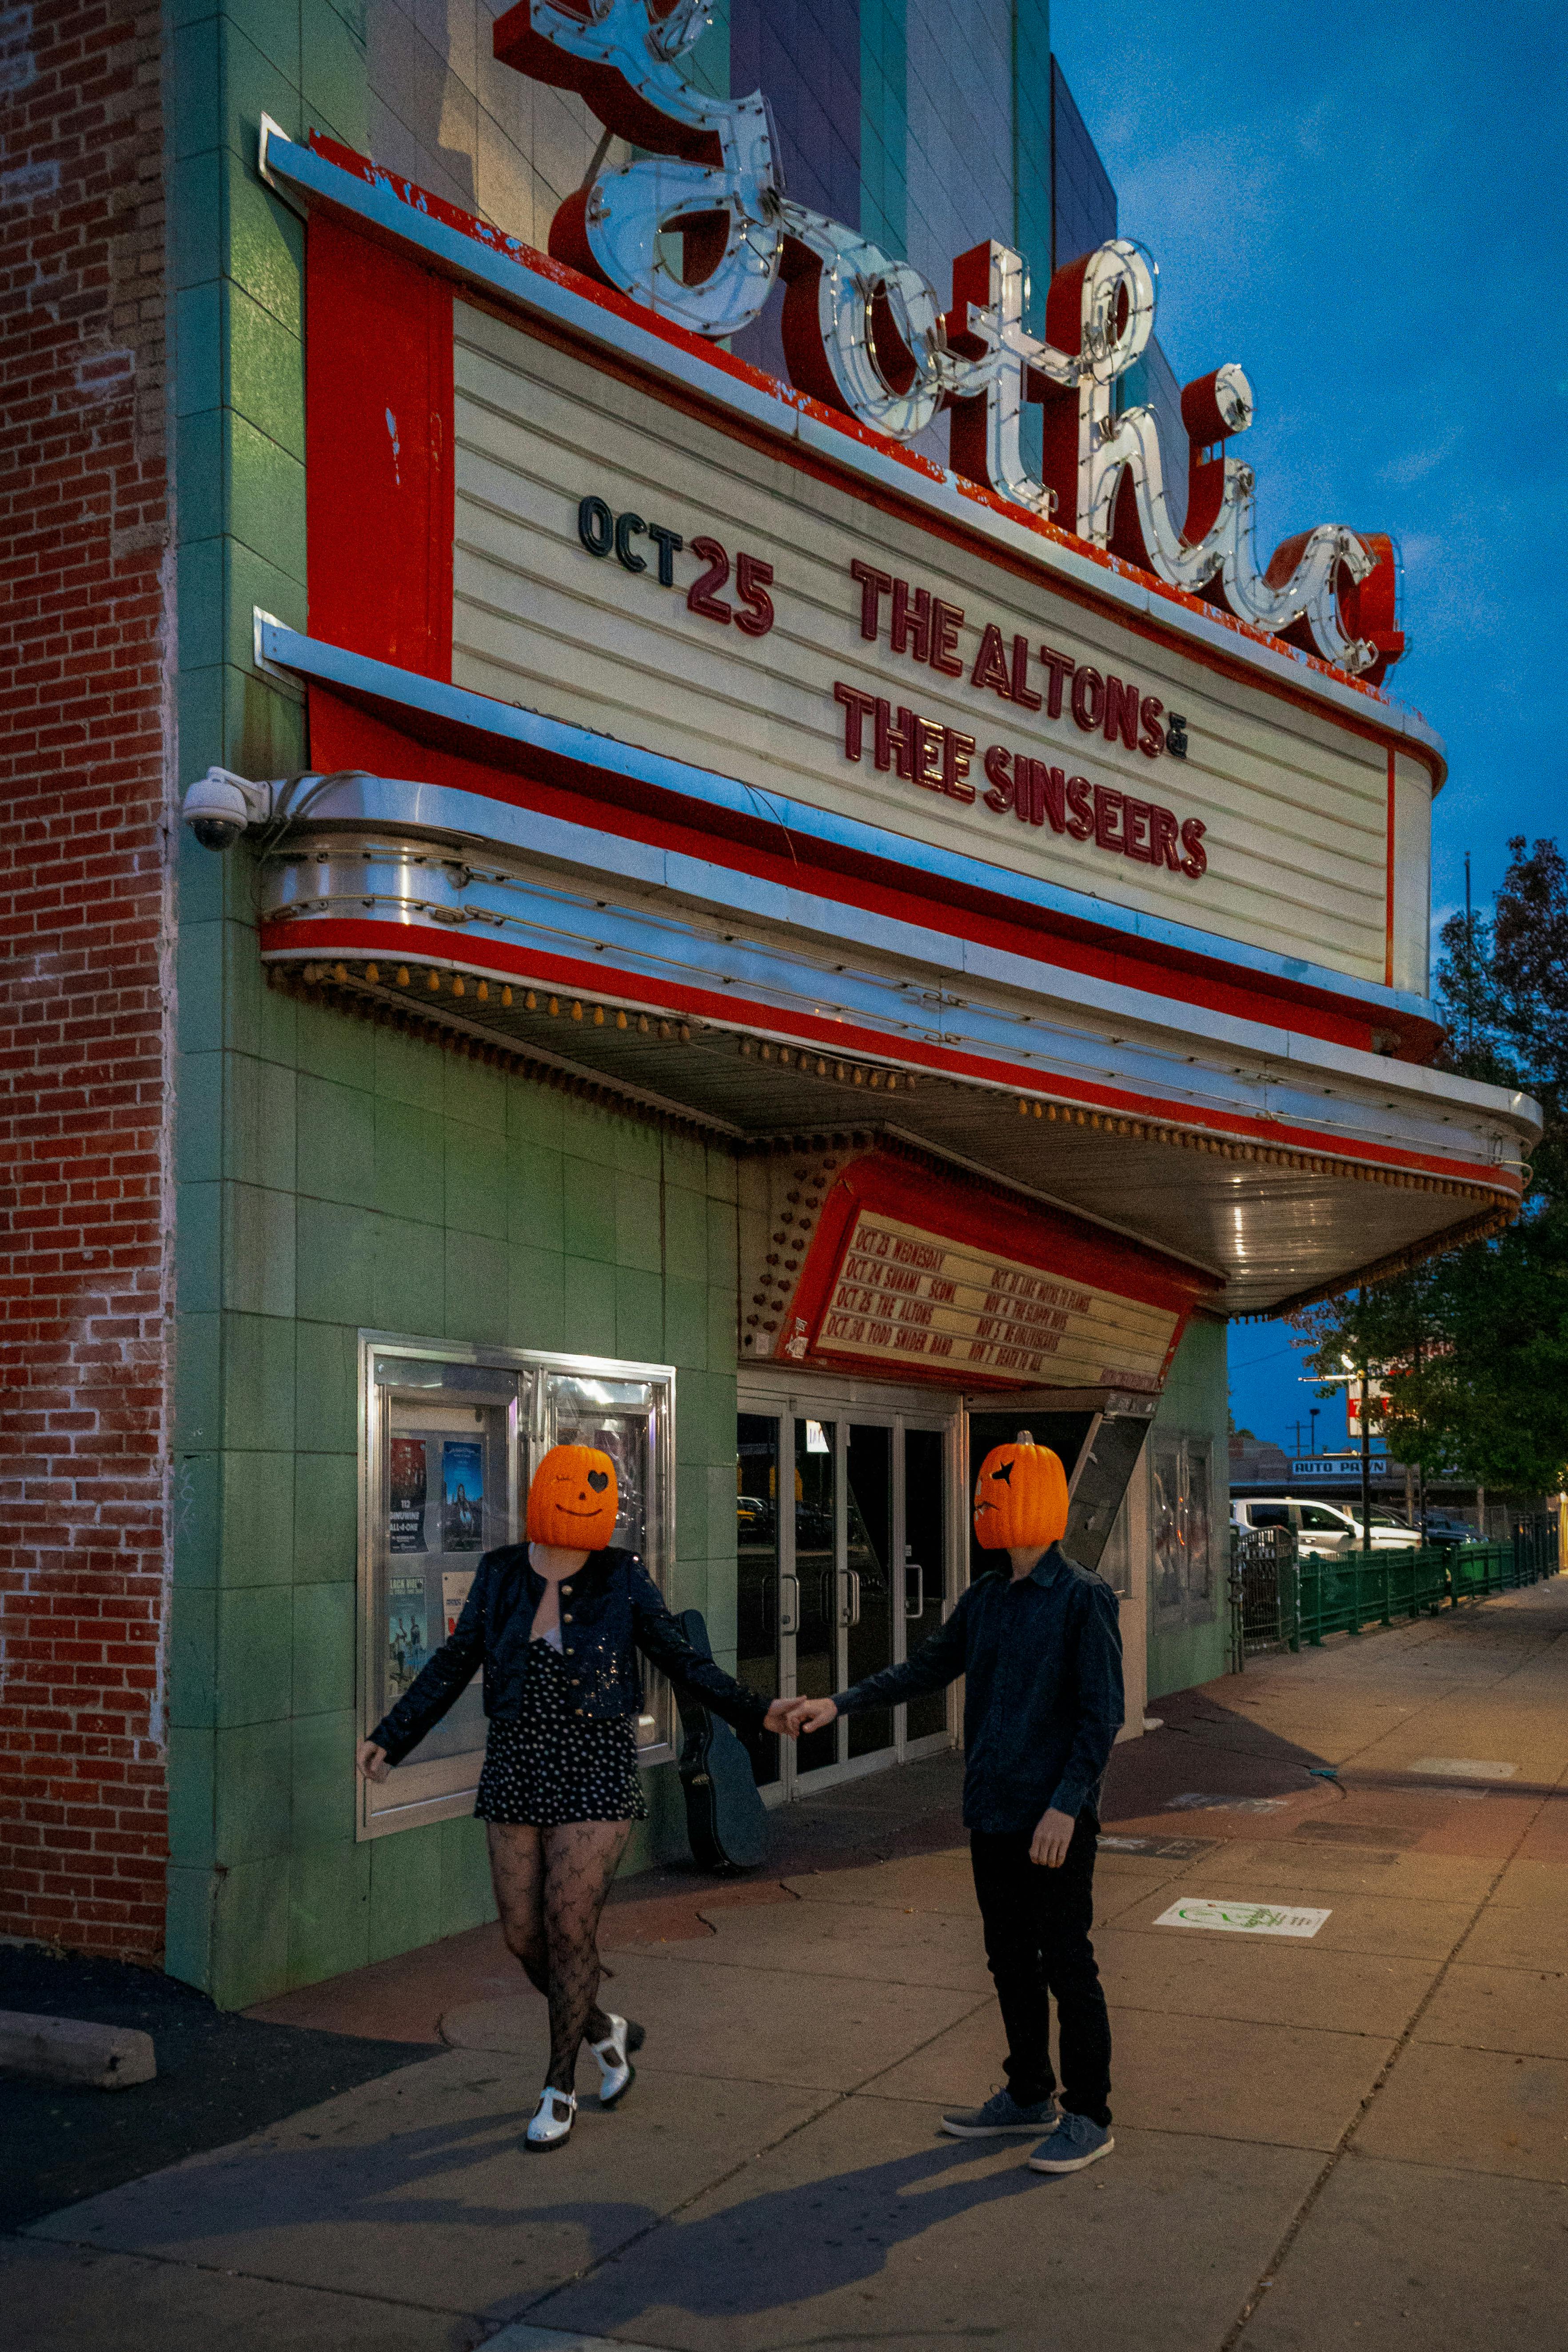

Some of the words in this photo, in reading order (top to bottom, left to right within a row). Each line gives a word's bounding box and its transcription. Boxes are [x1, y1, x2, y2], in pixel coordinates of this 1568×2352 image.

[578, 495, 683, 587] OCT
[687, 535, 774, 638] 25
[850, 558, 965, 678] THE
[971, 623, 1165, 759] ALTONS
[834, 681, 976, 804] THEE
[983, 745, 1207, 880] SINSEERS
[855, 1227, 877, 1251] OCT
[877, 1234, 890, 1255] 23
[893, 1239, 944, 1270] WEDNESDAY
[846, 1257, 867, 1279] OCT
[868, 1263, 882, 1283] 24
[836, 1286, 858, 1307] OCT
[859, 1291, 872, 1311] 25
[876, 1294, 895, 1315] THE
[899, 1300, 933, 1323] ALTONS
[826, 1314, 848, 1335] OCT
[850, 1319, 864, 1338] 30
[868, 1322, 892, 1343] TODD
[894, 1328, 927, 1350] SNIDER
[930, 1334, 953, 1354] BAND
[1295, 1462, 1333, 1472] AUTO
[1340, 1462, 1384, 1472] PAN
[401, 1500, 411, 1509] 112
